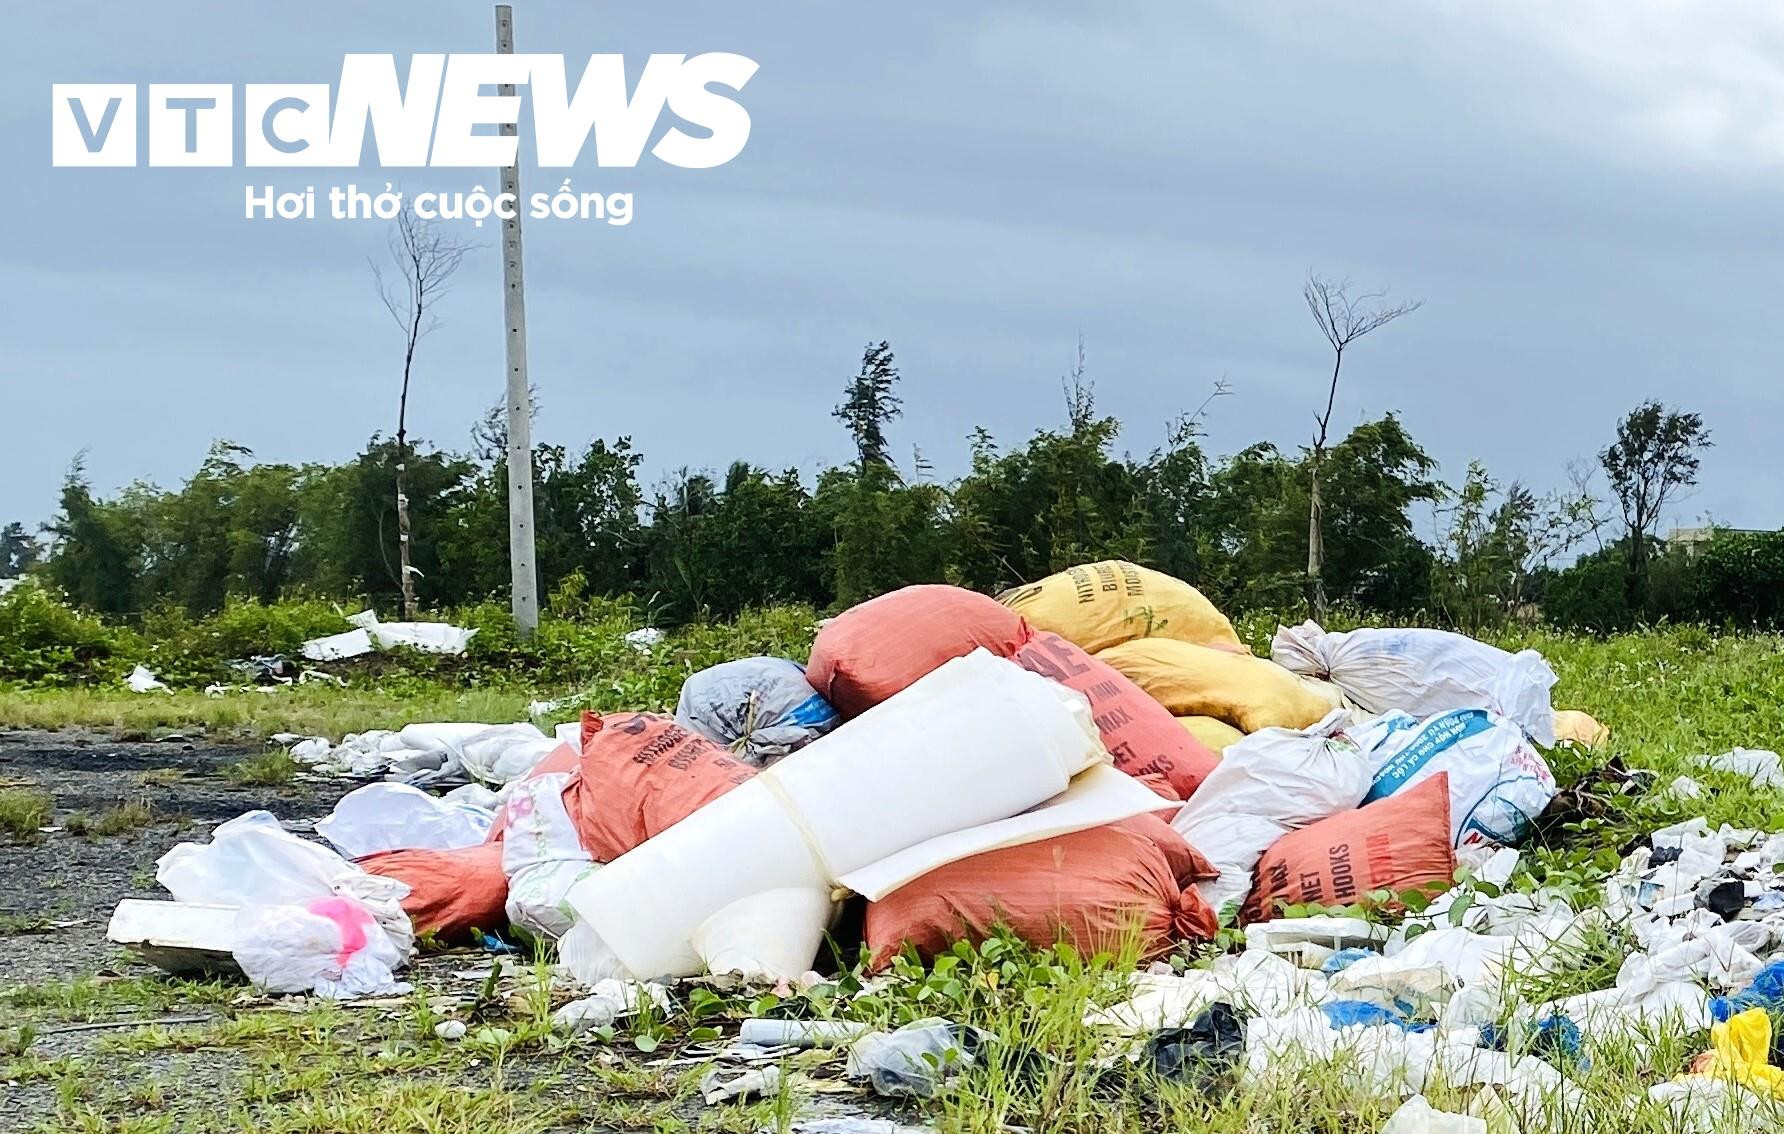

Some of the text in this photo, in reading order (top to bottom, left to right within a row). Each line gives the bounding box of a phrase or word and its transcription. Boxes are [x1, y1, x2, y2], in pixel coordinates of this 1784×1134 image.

[1112, 740, 1137, 766] ET
[1300, 871, 1324, 903] NET
[1328, 844, 1356, 899] HOOKS
